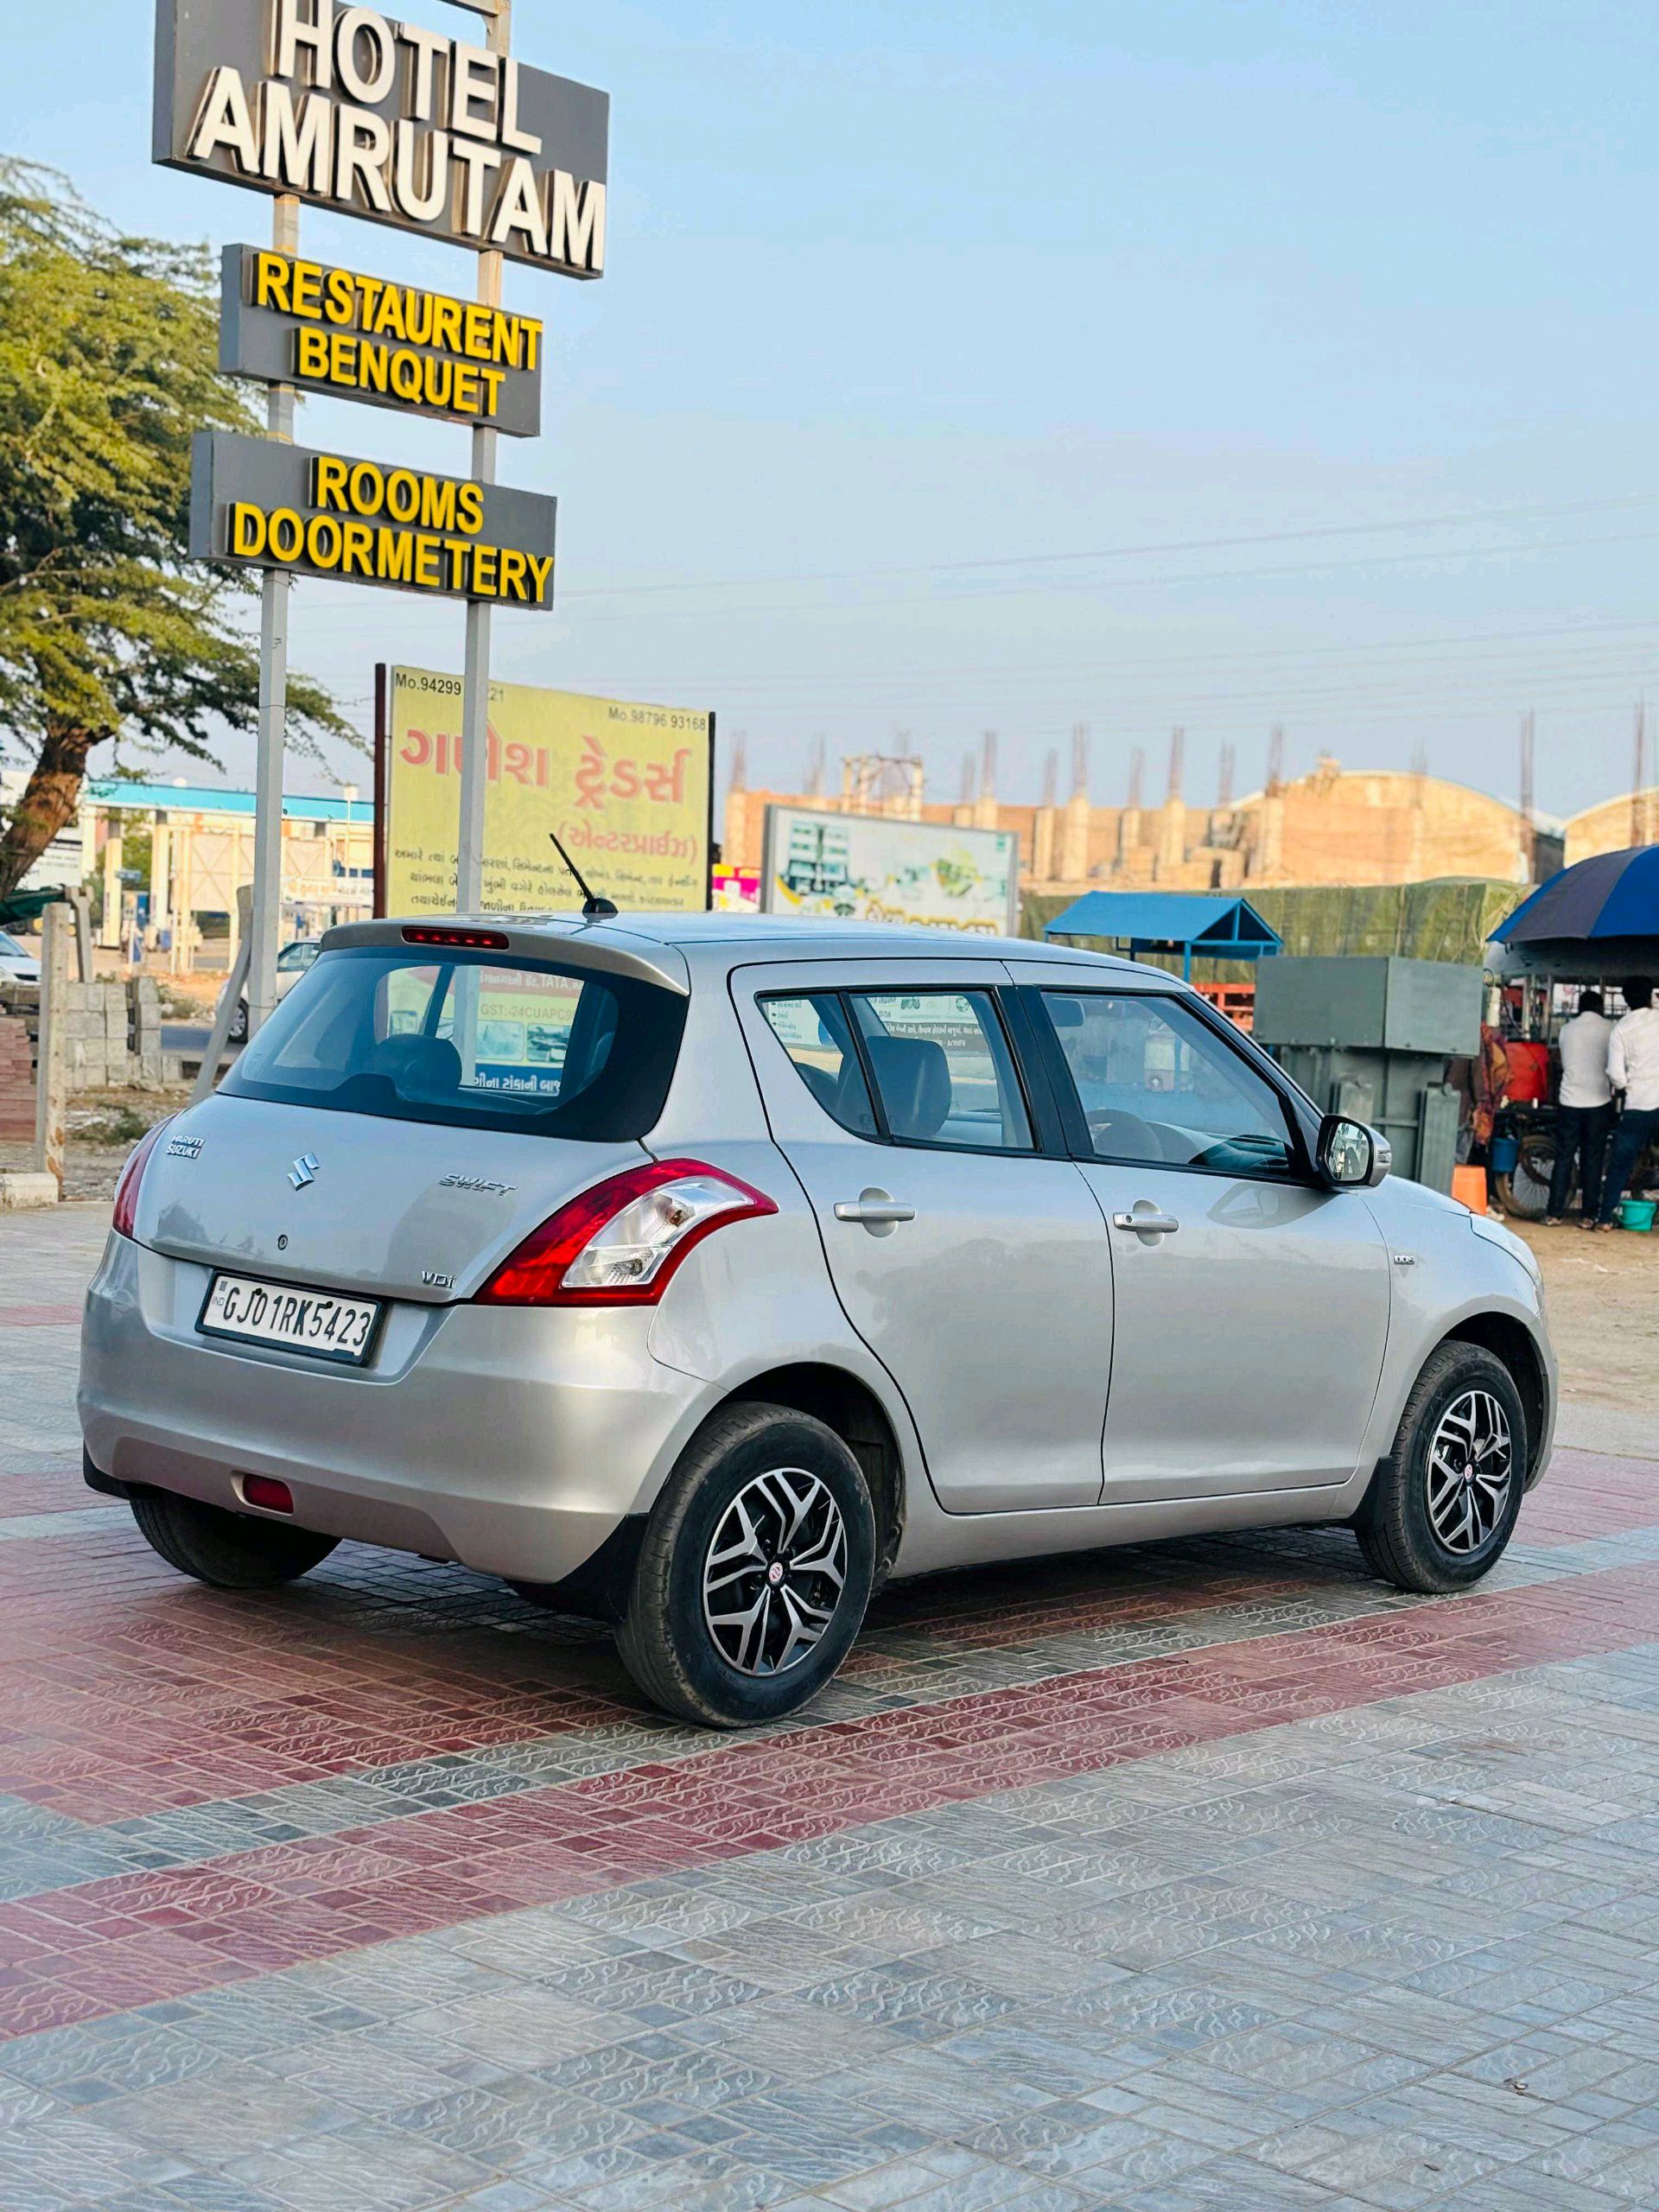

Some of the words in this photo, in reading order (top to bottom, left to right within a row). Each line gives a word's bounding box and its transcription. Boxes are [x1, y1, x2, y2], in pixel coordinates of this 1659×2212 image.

[273, 0, 543, 155] HOTEL
[190, 66, 606, 270] AMRUTAM
[256, 251, 543, 371] RESTAURENT
[296, 326, 506, 416] BENQUET
[315, 455, 485, 535] ROOMS
[232, 503, 554, 603] DOORMETERY
[395, 672, 461, 696] Mo.94299
[609, 706, 668, 727] Mo.98796
[671, 715, 707, 731] 93168
[166, 1143, 200, 1160] SUZUKI
[172, 1135, 206, 1148] MARUTI
[439, 1173, 518, 1197] SWIFT
[223, 1287, 372, 1347] GJ01RK5423
